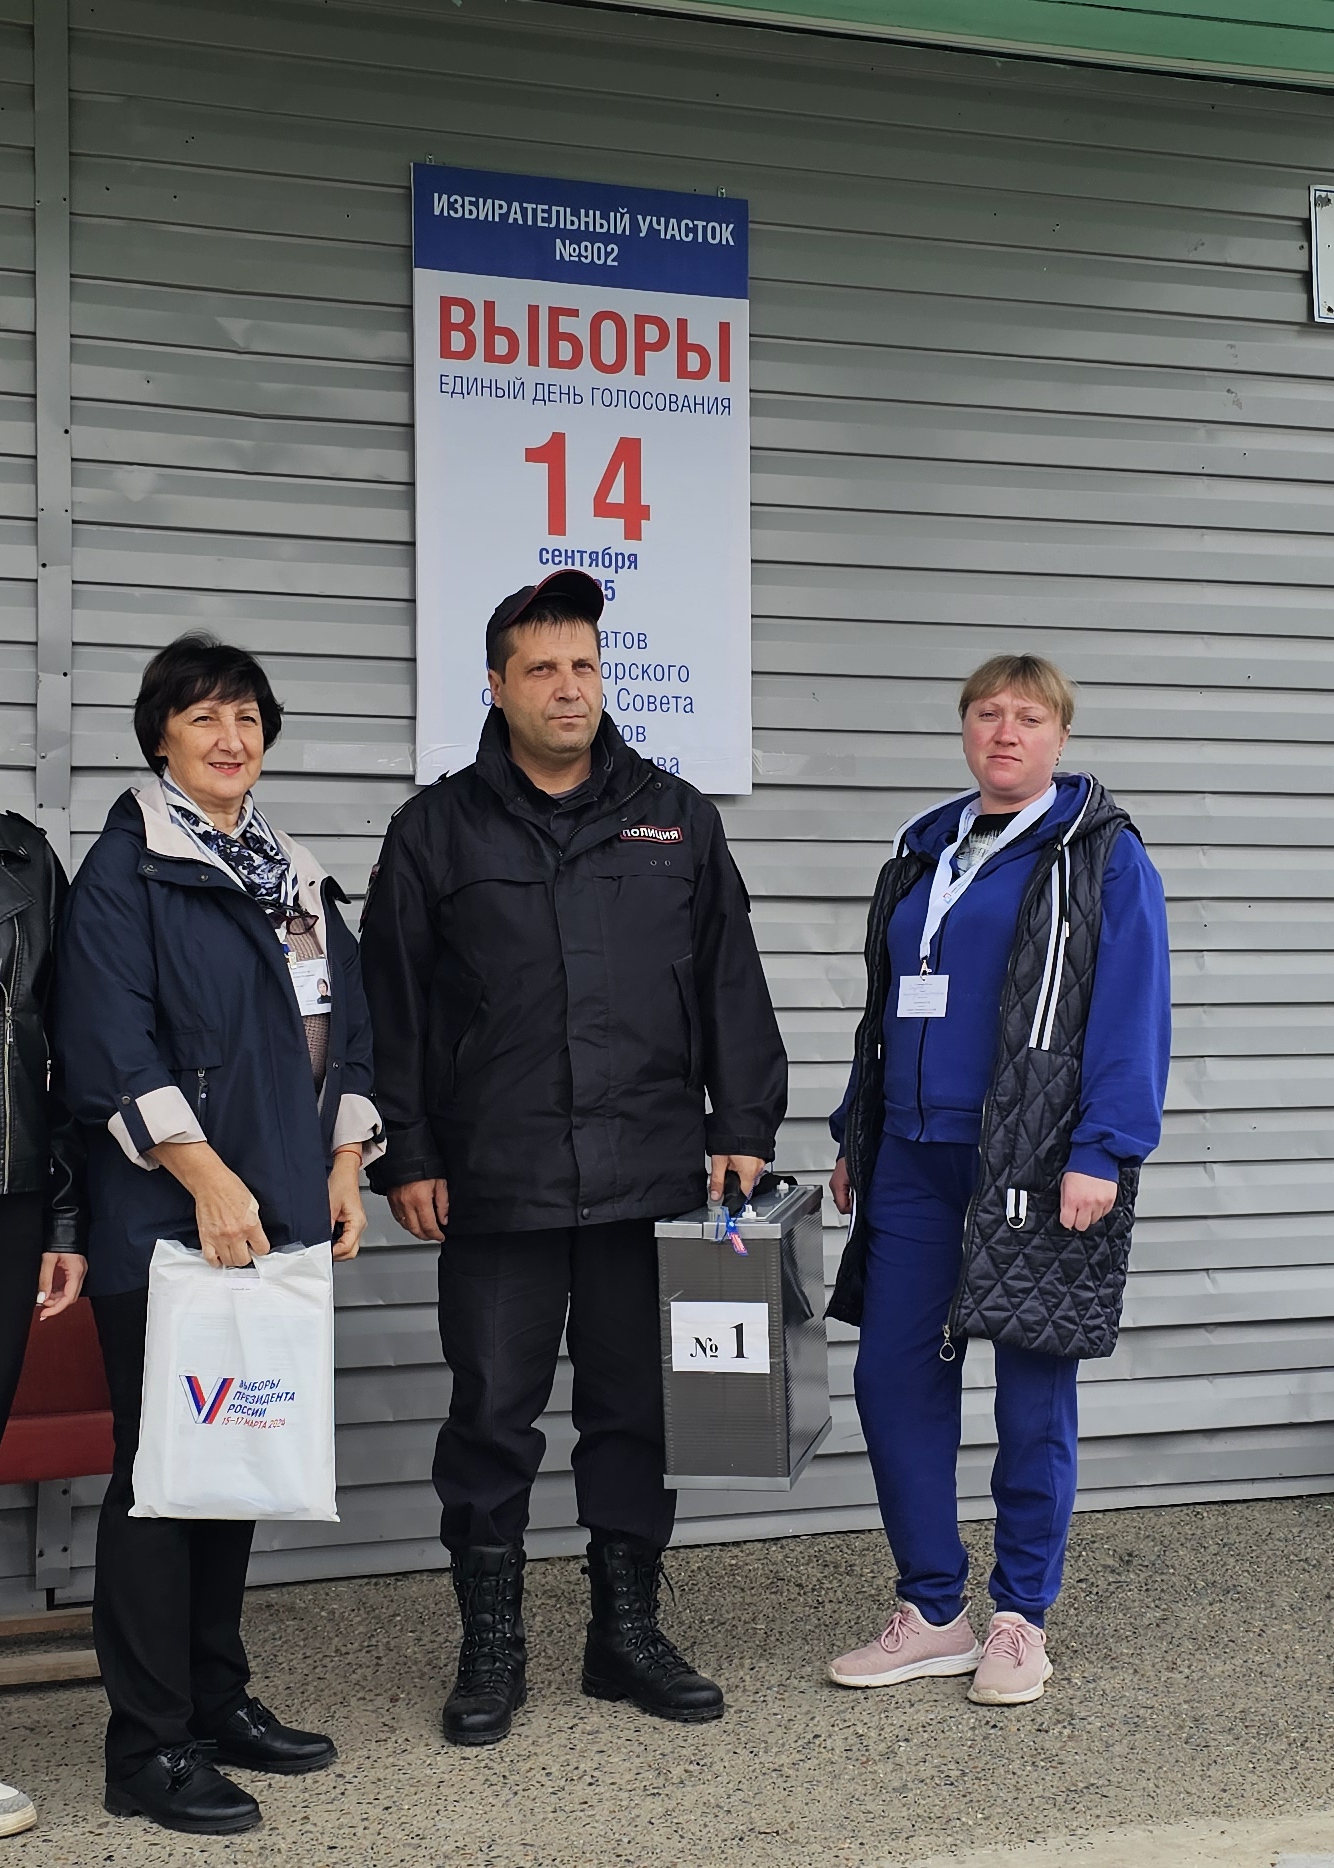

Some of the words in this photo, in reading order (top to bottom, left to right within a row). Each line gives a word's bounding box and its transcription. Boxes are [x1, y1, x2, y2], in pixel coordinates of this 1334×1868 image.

[433, 191, 631, 236] ИЗБИРАТЕЛЬНЫЙ
[637, 214, 735, 246] УЧАСТОК
[555, 238, 619, 266] №902
[439, 295, 731, 383] ВЫБОРЫ
[439, 374, 526, 401] ЕДИНЫЙ
[532, 382, 584, 407] ДЕНЬ
[591, 387, 732, 416] ГОЛОСОВАНИЯ
[524, 431, 651, 541] 14
[539, 546, 638, 574] сентября
[599, 630, 648, 650] атов
[600, 661, 690, 685] орского
[617, 687, 695, 714] Совета
[689, 1336, 718, 1359] №
[729, 1322, 750, 1359] 1
[232, 1391, 296, 1405] ПРЕЗИДЕНТА
[238, 1378, 281, 1392] ВЫБОРЫ
[226, 1404, 267, 1418] РОССИИ
[244, 1418, 268, 1429] МАРТА
